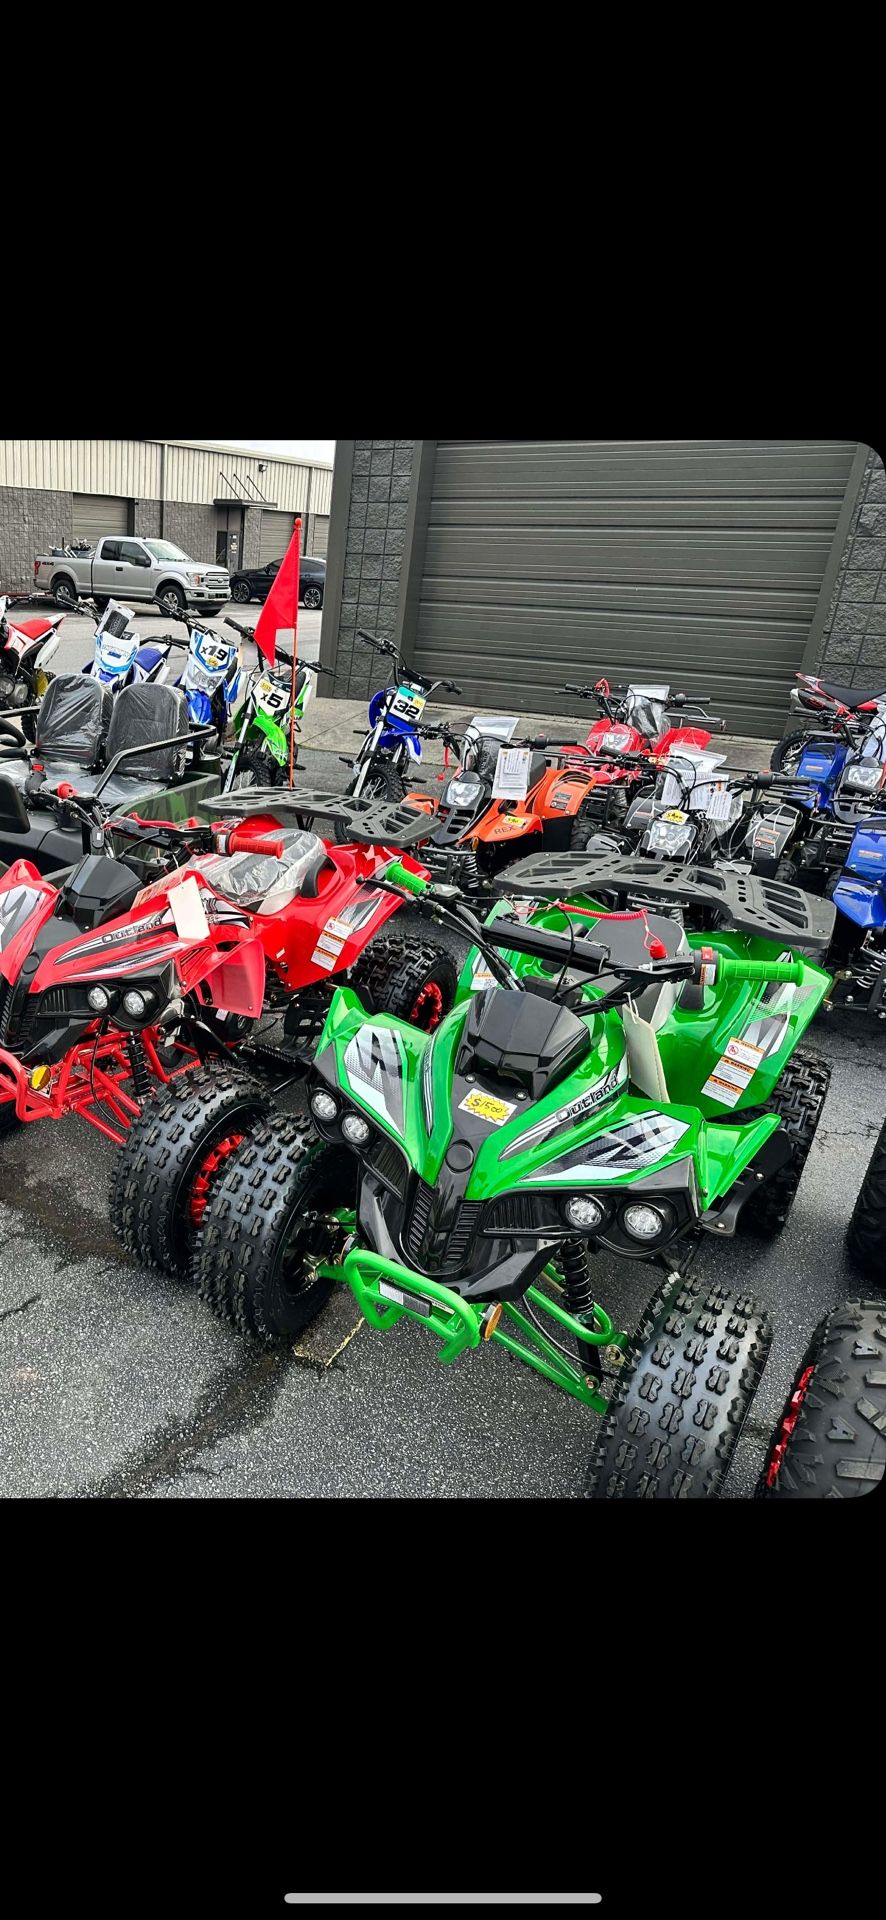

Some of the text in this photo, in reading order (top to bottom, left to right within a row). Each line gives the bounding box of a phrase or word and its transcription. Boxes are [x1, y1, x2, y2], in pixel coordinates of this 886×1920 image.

[393, 699, 420, 719] 32
[494, 825, 515, 834] REX
[101, 915, 162, 943] Outland
[471, 1097, 503, 1113] $1500
[555, 1074, 618, 1122] Outland
